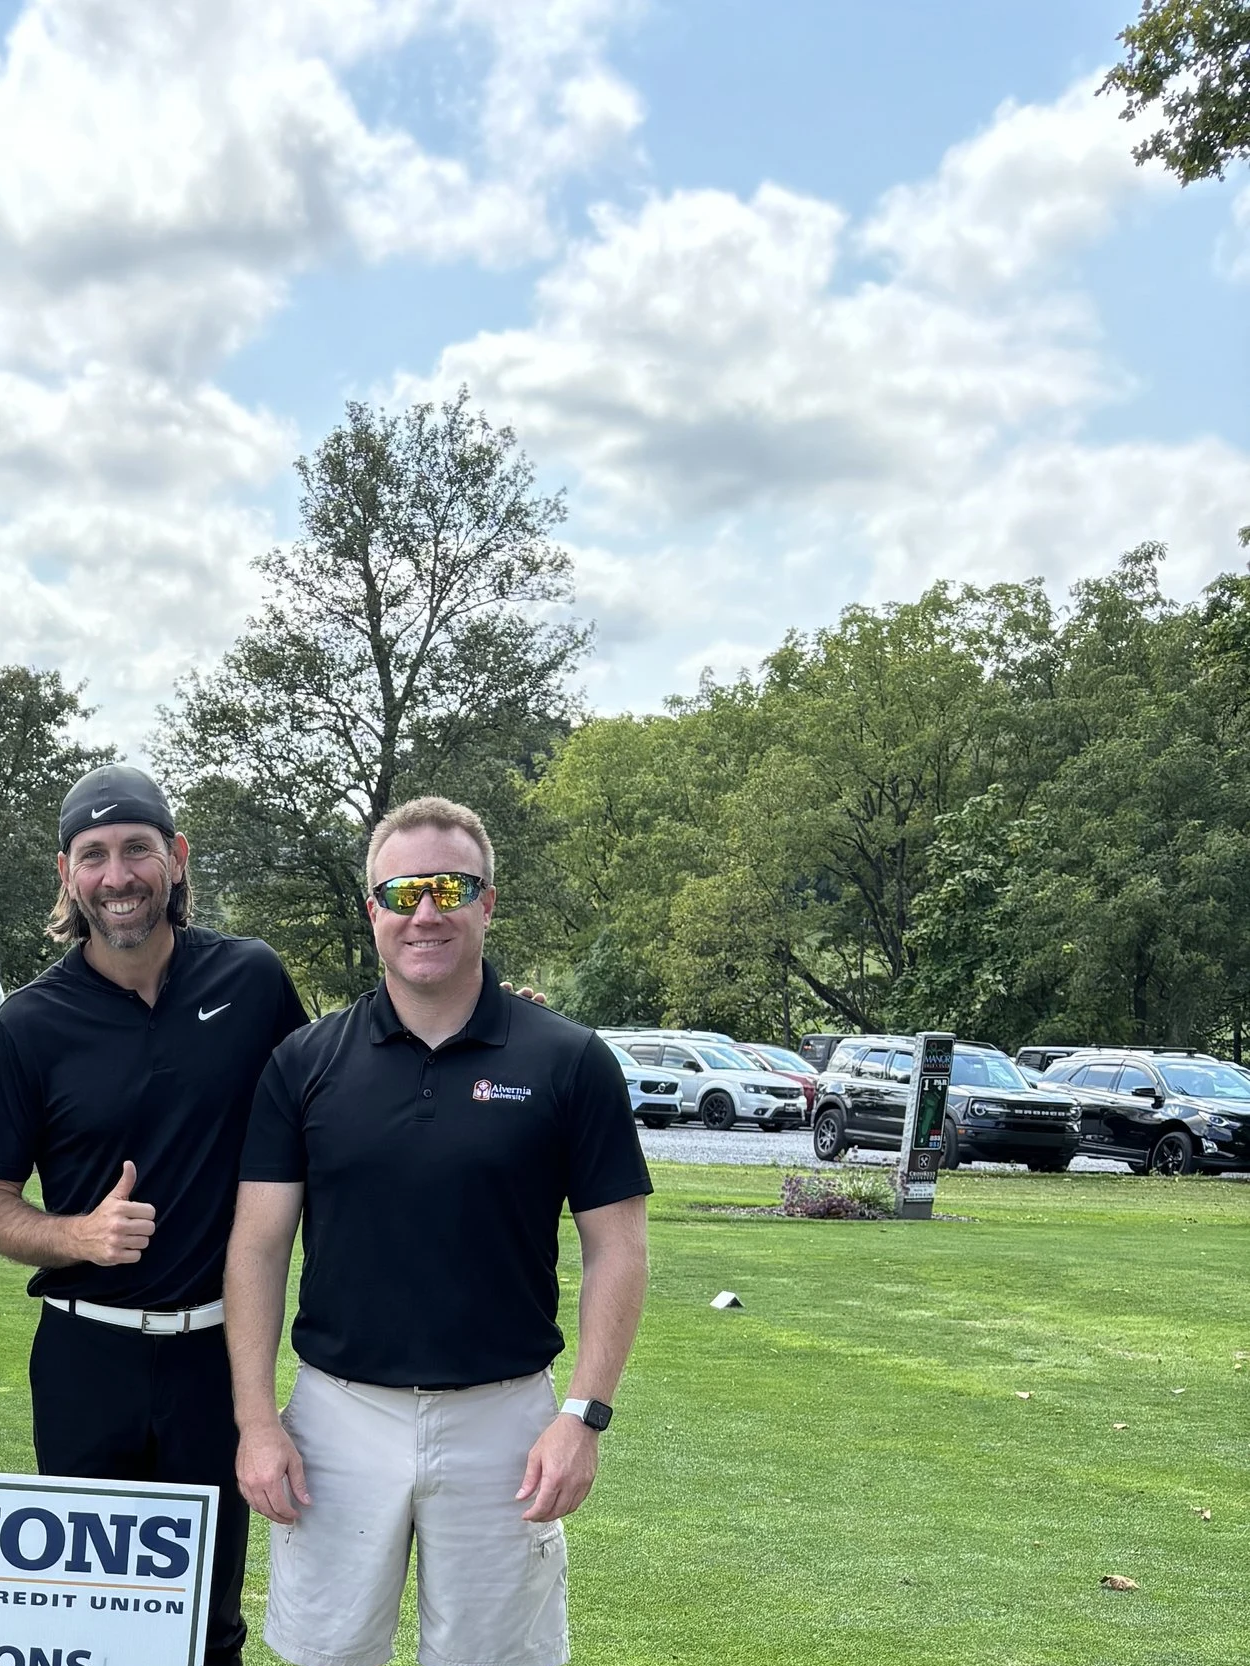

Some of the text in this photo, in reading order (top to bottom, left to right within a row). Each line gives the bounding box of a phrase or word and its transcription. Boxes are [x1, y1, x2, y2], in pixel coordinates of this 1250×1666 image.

[925, 1055, 951, 1064] MANOR
[491, 1084, 531, 1095] Alvernia
[923, 1079, 930, 1091] 1
[490, 1092, 525, 1101] University
[1014, 1109, 1066, 1117] BRONCO
[89, 1595, 185, 1615] UNION
